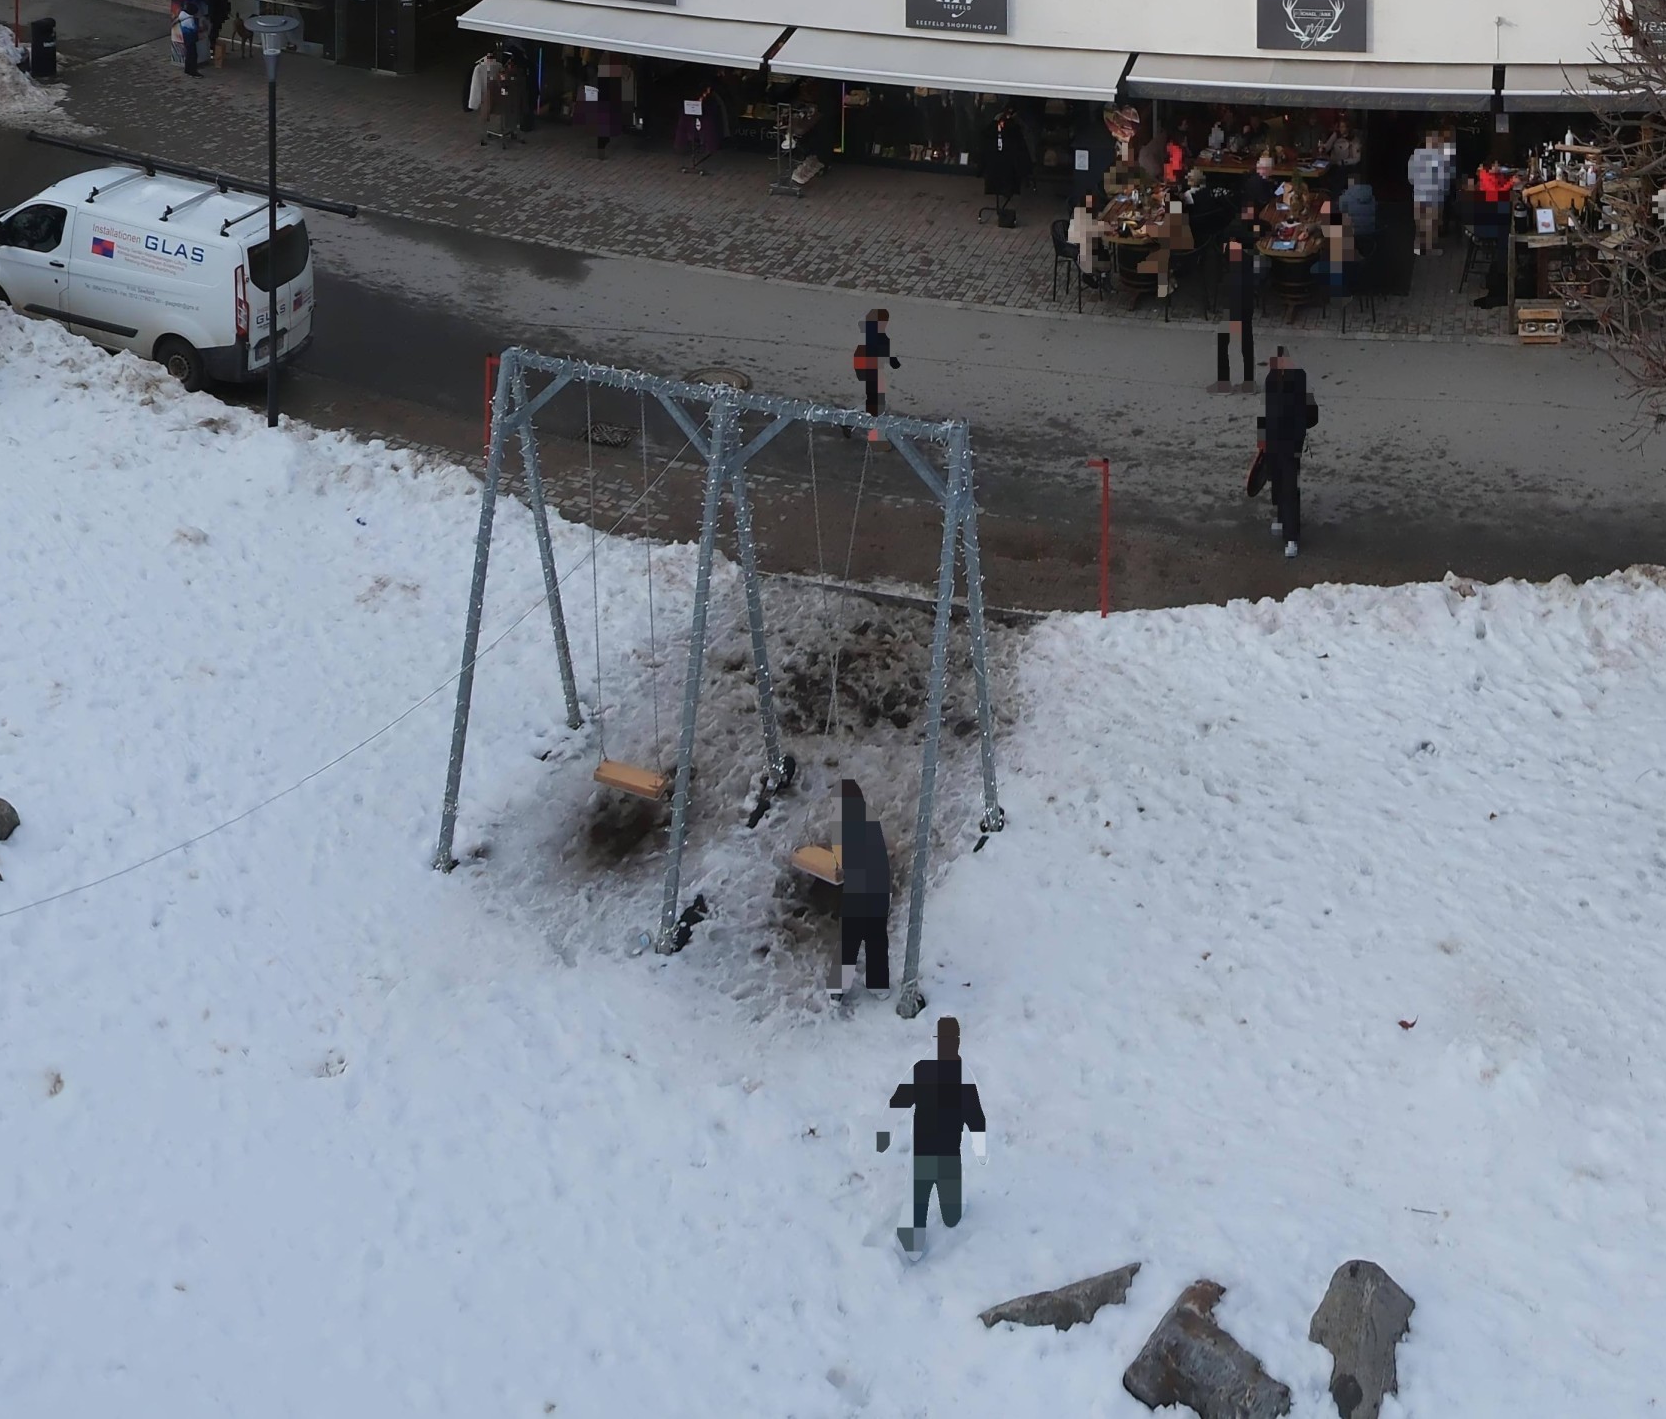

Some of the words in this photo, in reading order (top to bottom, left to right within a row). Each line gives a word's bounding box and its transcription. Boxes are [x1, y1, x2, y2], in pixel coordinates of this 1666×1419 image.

[947, 22, 982, 30] SHOPPING
[92, 223, 141, 244] Installationen
[144, 235, 204, 263] GLAS
[256, 303, 286, 325] GLS
